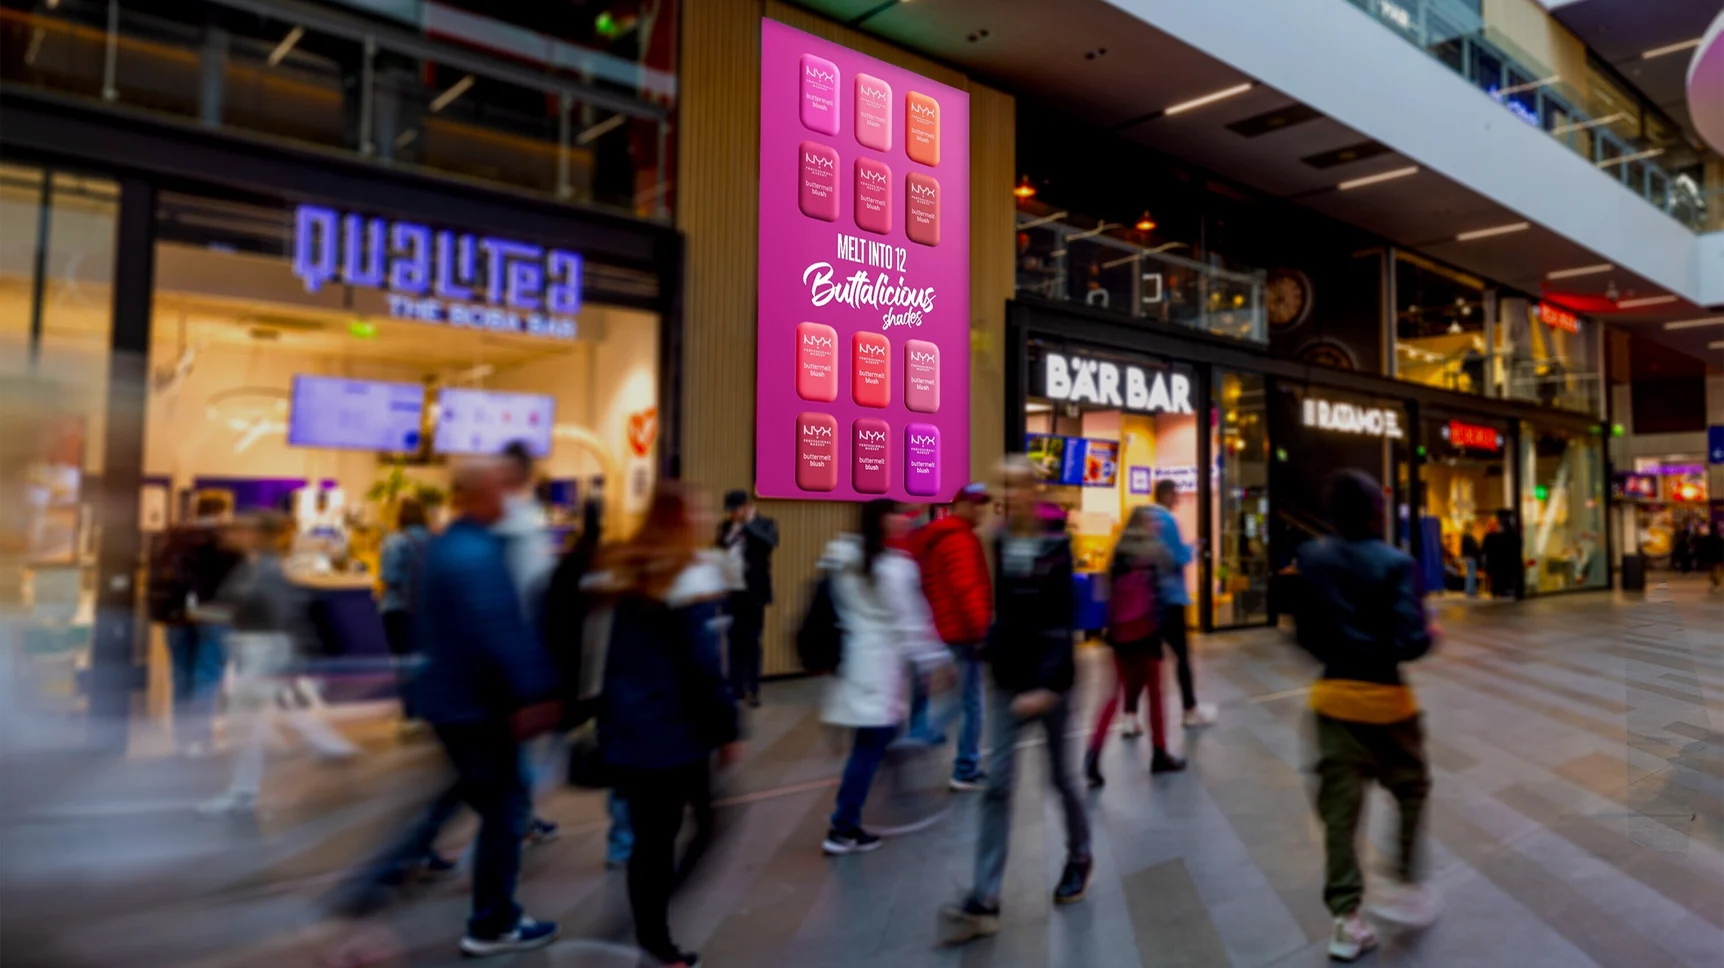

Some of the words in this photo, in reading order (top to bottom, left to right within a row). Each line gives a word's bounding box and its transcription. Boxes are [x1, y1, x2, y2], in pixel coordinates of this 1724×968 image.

[806, 65, 834, 83] NYX
[861, 85, 886, 101] NYX
[806, 92, 834, 107] buttermelt
[812, 102, 828, 112] blush
[912, 102, 935, 118] NYX
[861, 111, 886, 124] buttermelt
[866, 119, 880, 128] blush
[912, 128, 935, 140] buttermelt
[917, 135, 929, 144] blush
[806, 153, 833, 169] NYX
[861, 168, 886, 184] NYX
[806, 180, 833, 192] buttermelt
[912, 183, 935, 198] NYX
[812, 188, 826, 198] blush
[861, 195, 886, 206] buttermelt
[867, 202, 880, 212] blush
[912, 209, 935, 220] buttermelt
[917, 216, 929, 224] blush
[837, 233, 866, 264] MELT
[869, 240, 892, 270] INTO
[895, 247, 906, 272] 12
[803, 261, 936, 313] Buttalicious
[387, 293, 442, 321] THE
[450, 305, 519, 331] BOBA
[528, 314, 577, 339] BAR
[882, 306, 923, 330] shades
[804, 334, 832, 348] NYX
[859, 343, 885, 356] NYX
[911, 351, 935, 364] NYX
[804, 362, 832, 372] buttermelt
[810, 369, 825, 378] blush
[859, 370, 885, 379] buttermelt
[865, 376, 879, 385] blush
[911, 376, 935, 386] buttermelt
[1046, 353, 1123, 407] BÄR
[1126, 366, 1193, 415] BAR
[916, 383, 929, 391] blush
[803, 425, 831, 437] NYX
[859, 430, 885, 442] NYX
[911, 434, 935, 446] NYX
[803, 452, 831, 462] buttermelt
[859, 456, 885, 465] buttermelt
[810, 460, 825, 468] blush
[865, 463, 879, 471] blush
[911, 460, 935, 468] buttermelt
[917, 466, 929, 474] blush
